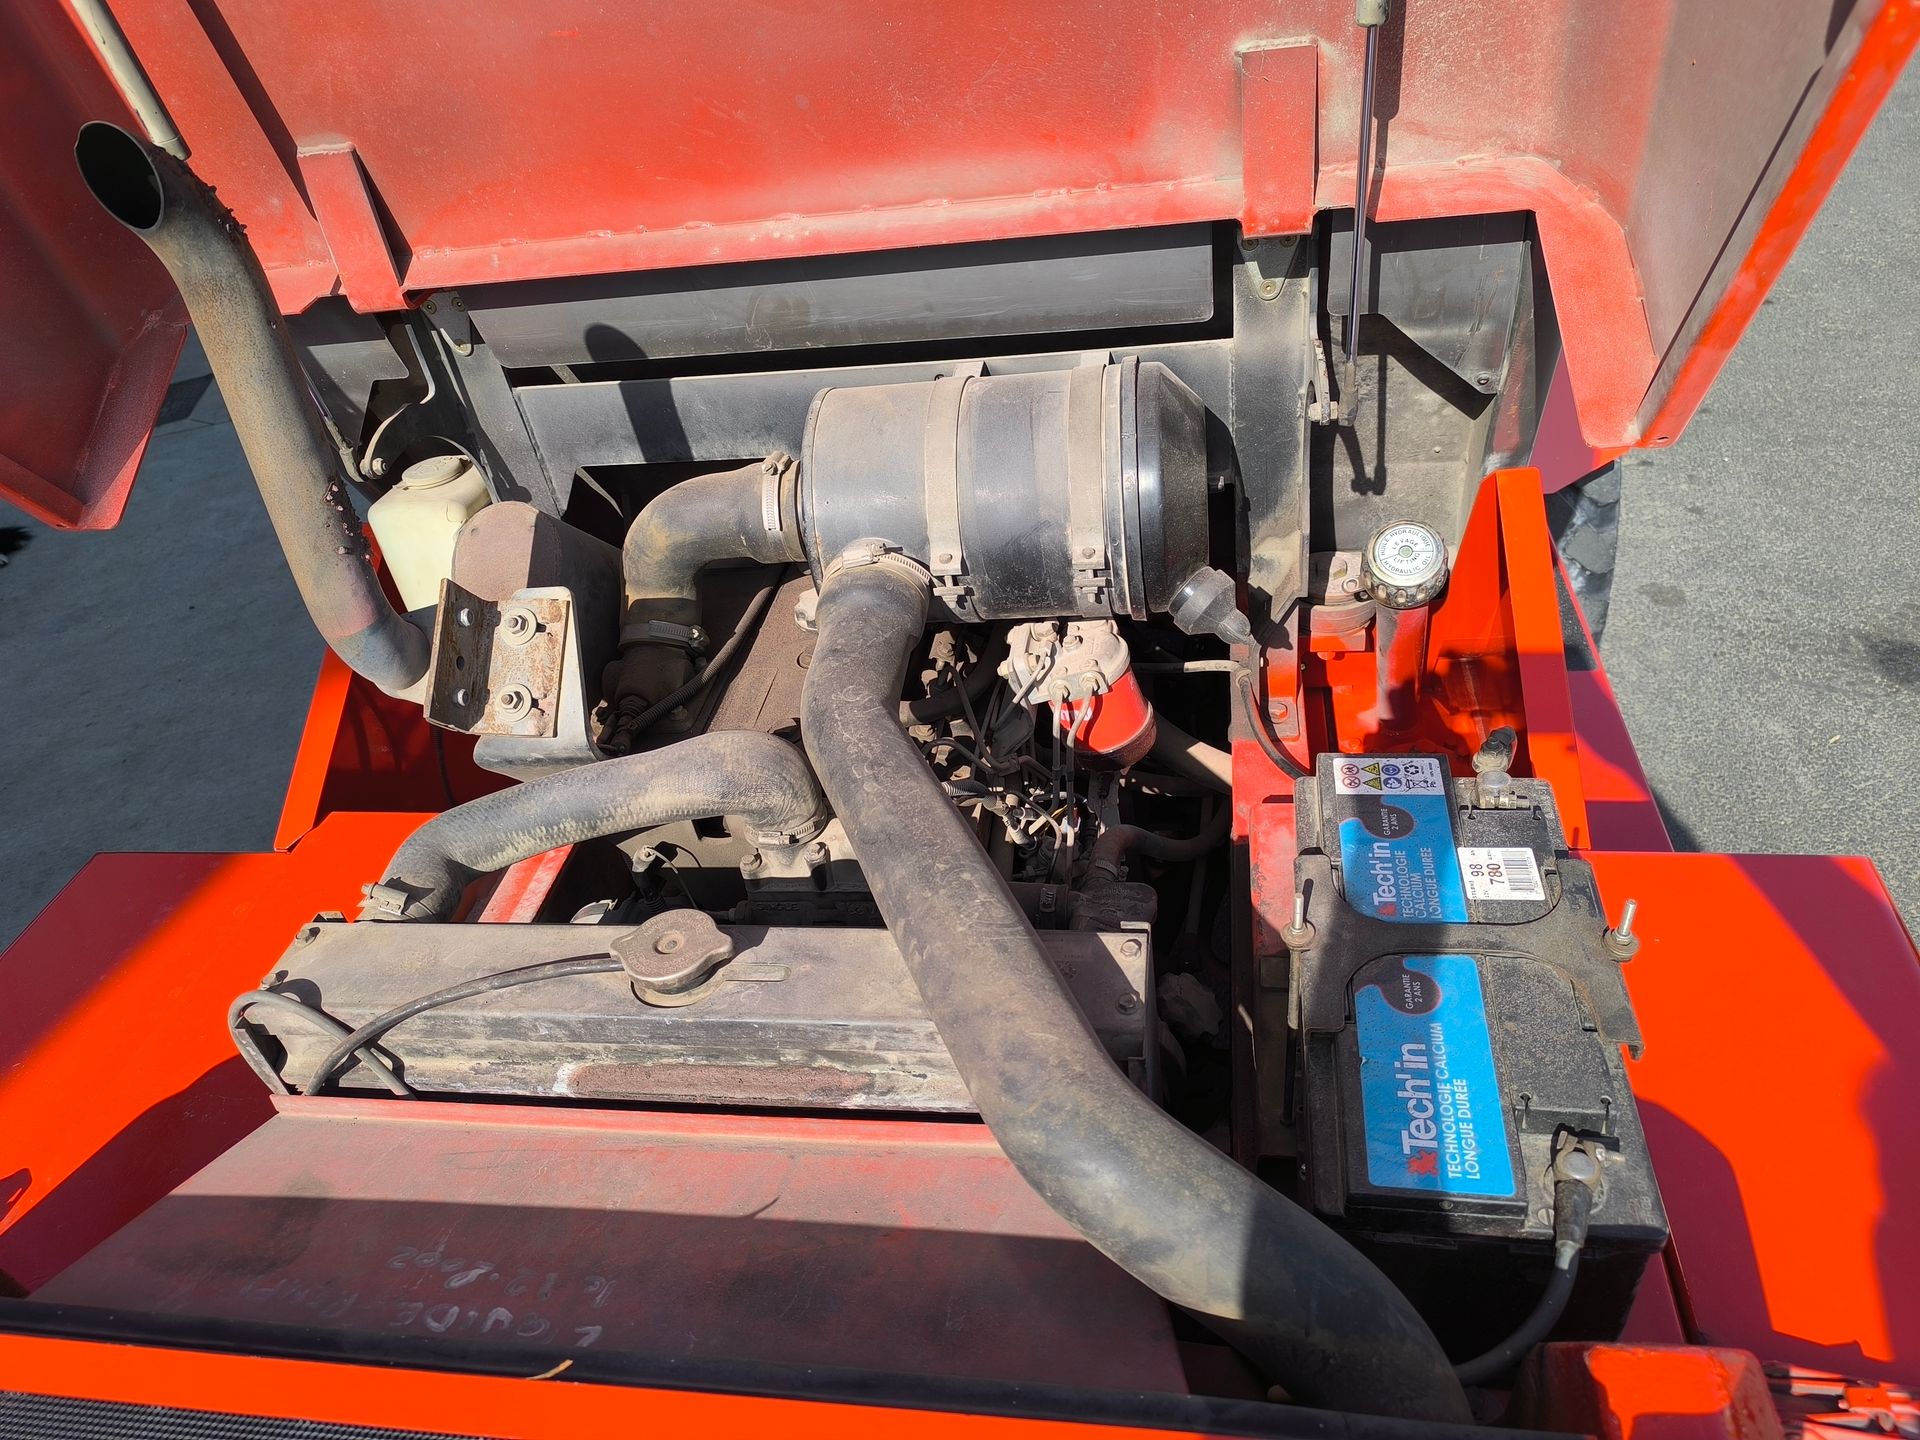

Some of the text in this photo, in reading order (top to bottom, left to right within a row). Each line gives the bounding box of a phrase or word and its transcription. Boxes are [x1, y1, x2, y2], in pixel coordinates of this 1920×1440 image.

[1380, 529, 1431, 556] HUILE HYDRAULIQUE
[1392, 538, 1419, 550] LEVAGE
[1384, 554, 1431, 574] HYDRAULIC OIL
[1393, 553, 1421, 564] LIFTING
[1380, 808, 1391, 836] GARANTIE
[1389, 813, 1398, 826] ANS
[1368, 842, 1396, 906] Tech'in
[1394, 850, 1414, 918] TECHNOLOGIE
[1418, 847, 1443, 919] LONGUE DURÉE
[1469, 863, 1485, 877] 98
[1486, 863, 1505, 885] 780
[1410, 873, 1427, 919] CALCIUM
[1403, 973, 1414, 1010] GARANTIE
[1413, 981, 1422, 997] ANS
[1394, 1042, 1438, 1154] Tech'in
[1430, 1022, 1461, 1179] TECHNOLOGIE CALCIUM
[1453, 1078, 1481, 1180] LONGUE DURÉE
